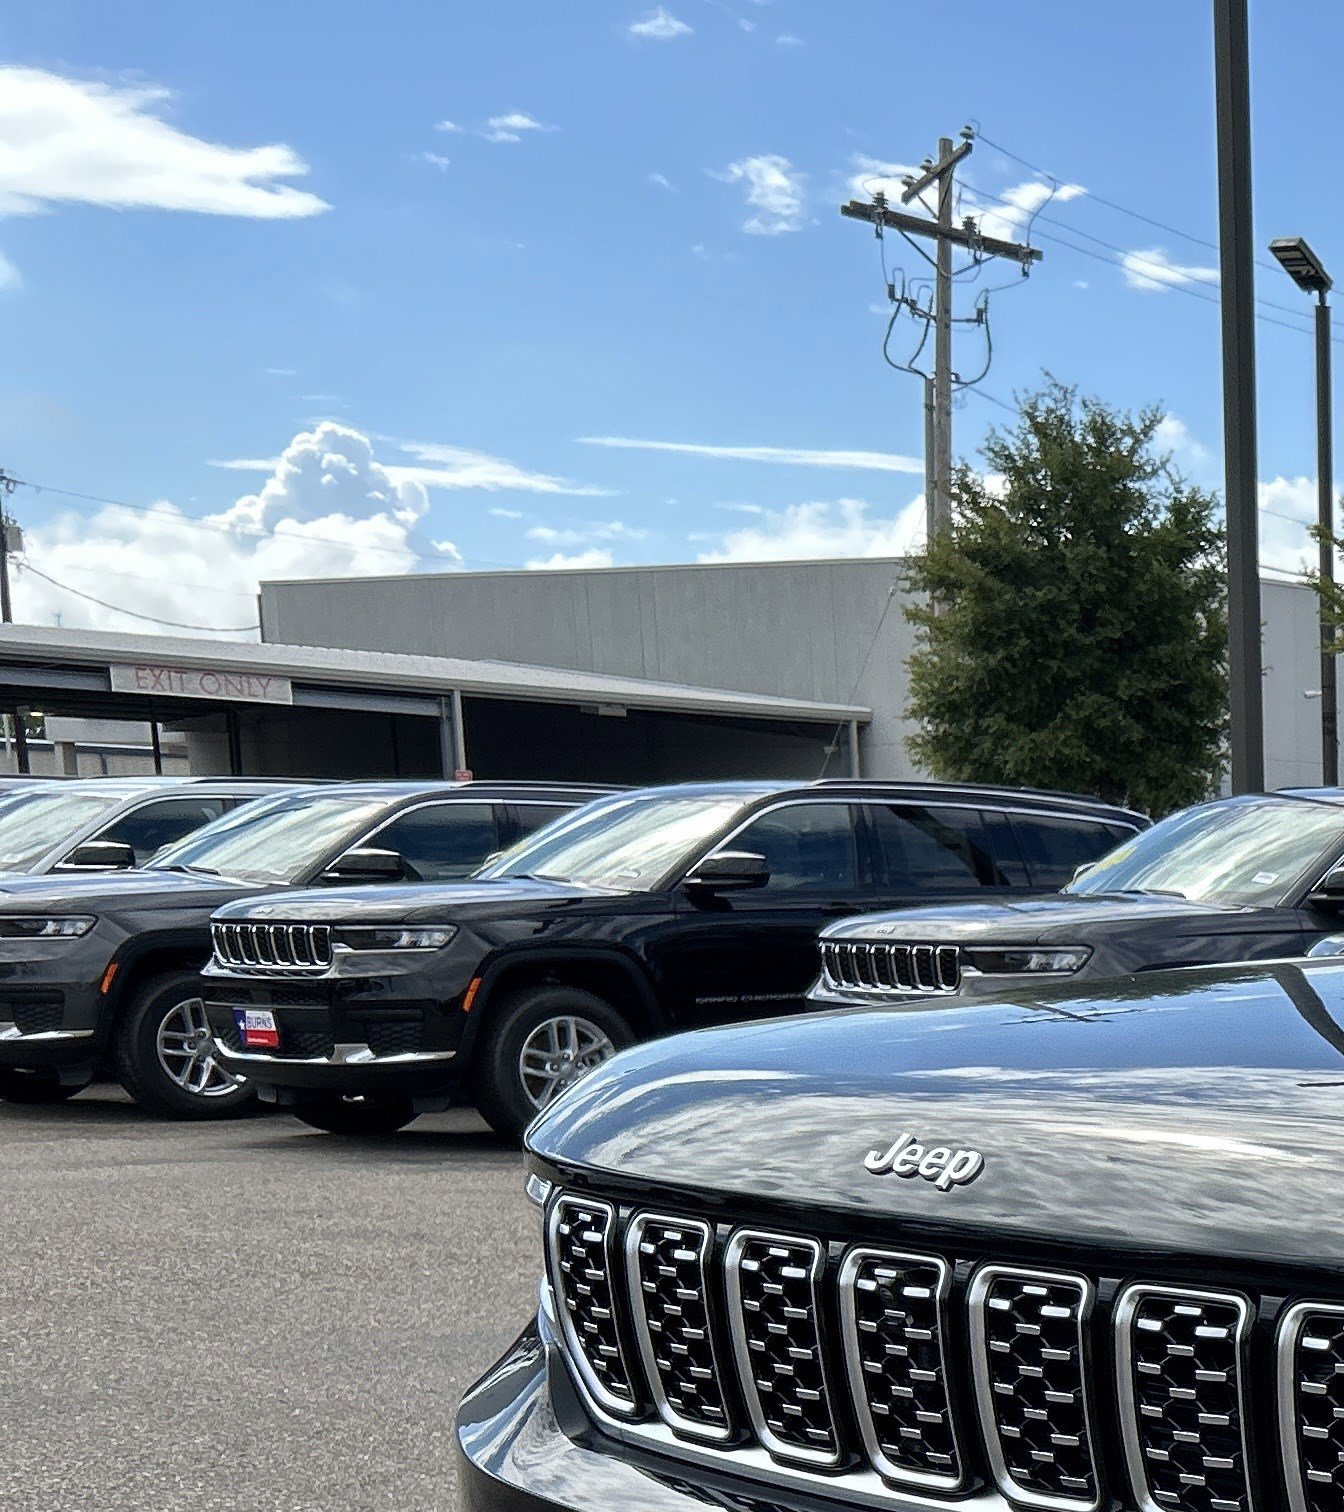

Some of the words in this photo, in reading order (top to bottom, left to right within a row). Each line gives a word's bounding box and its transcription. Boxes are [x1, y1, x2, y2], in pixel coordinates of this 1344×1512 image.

[135, 666, 188, 693] EXIT
[199, 671, 272, 698] ONLY
[864, 1133, 985, 1191] Jeep
